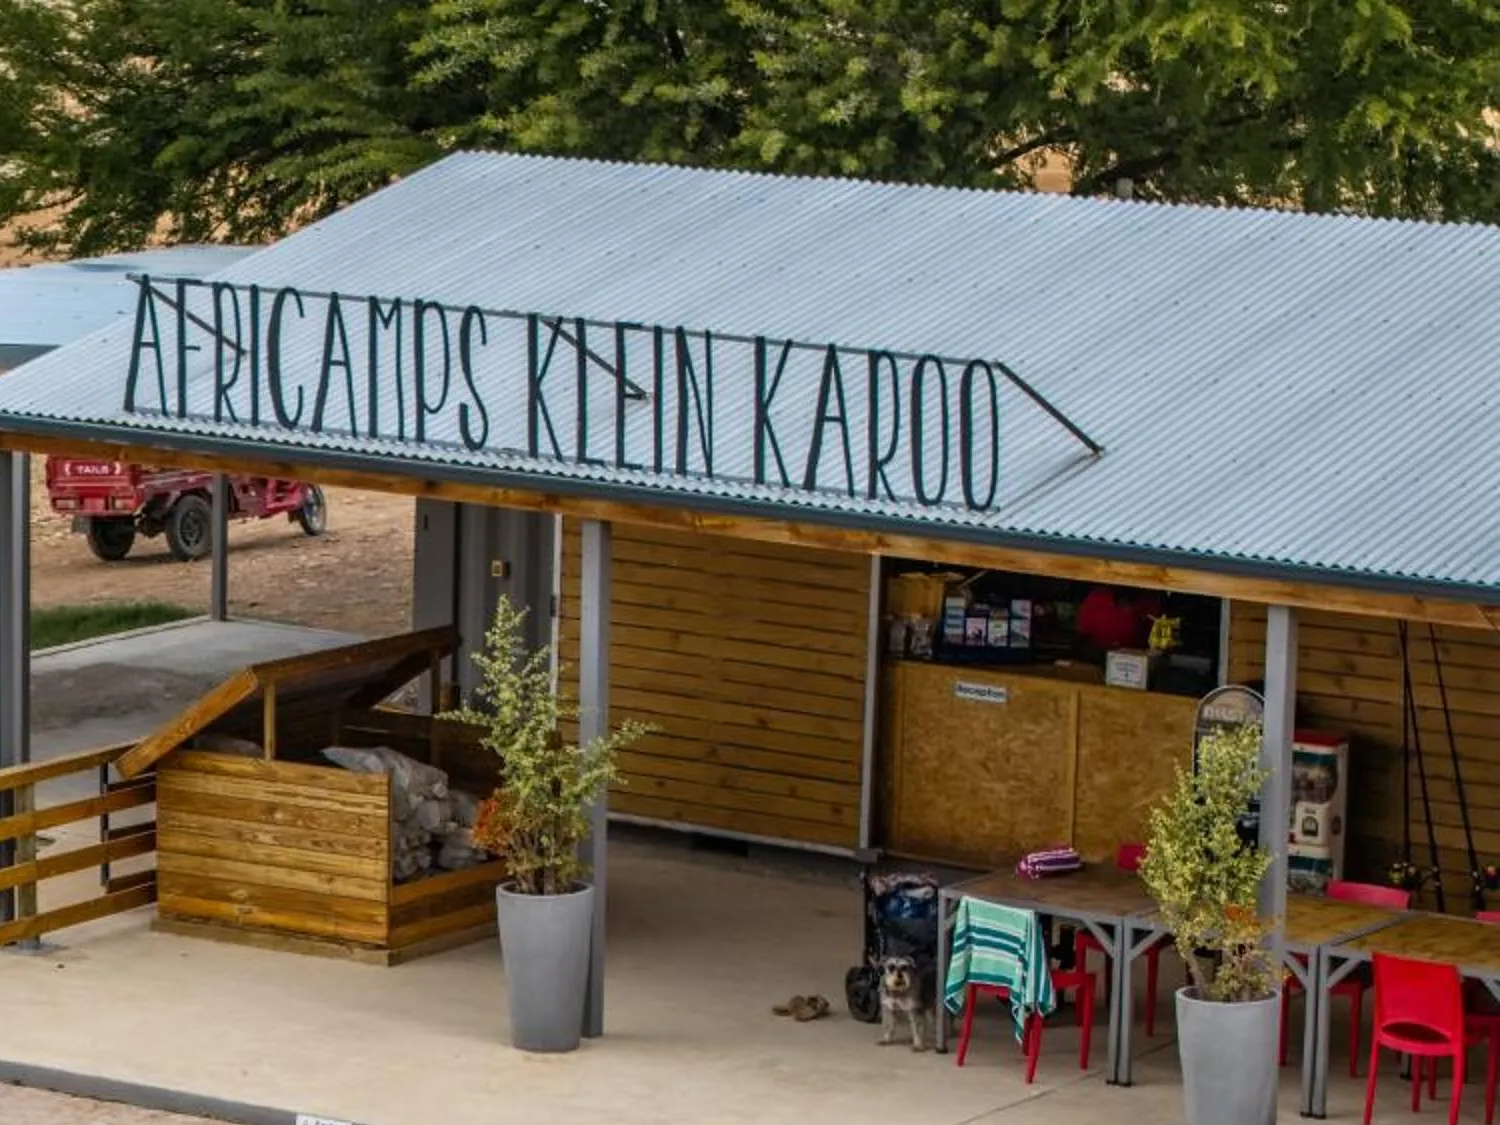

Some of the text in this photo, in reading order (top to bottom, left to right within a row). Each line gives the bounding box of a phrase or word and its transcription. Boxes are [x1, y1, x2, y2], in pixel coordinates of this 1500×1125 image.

[124, 274, 1000, 510] AFRICAMPS KLEIN KAROO
